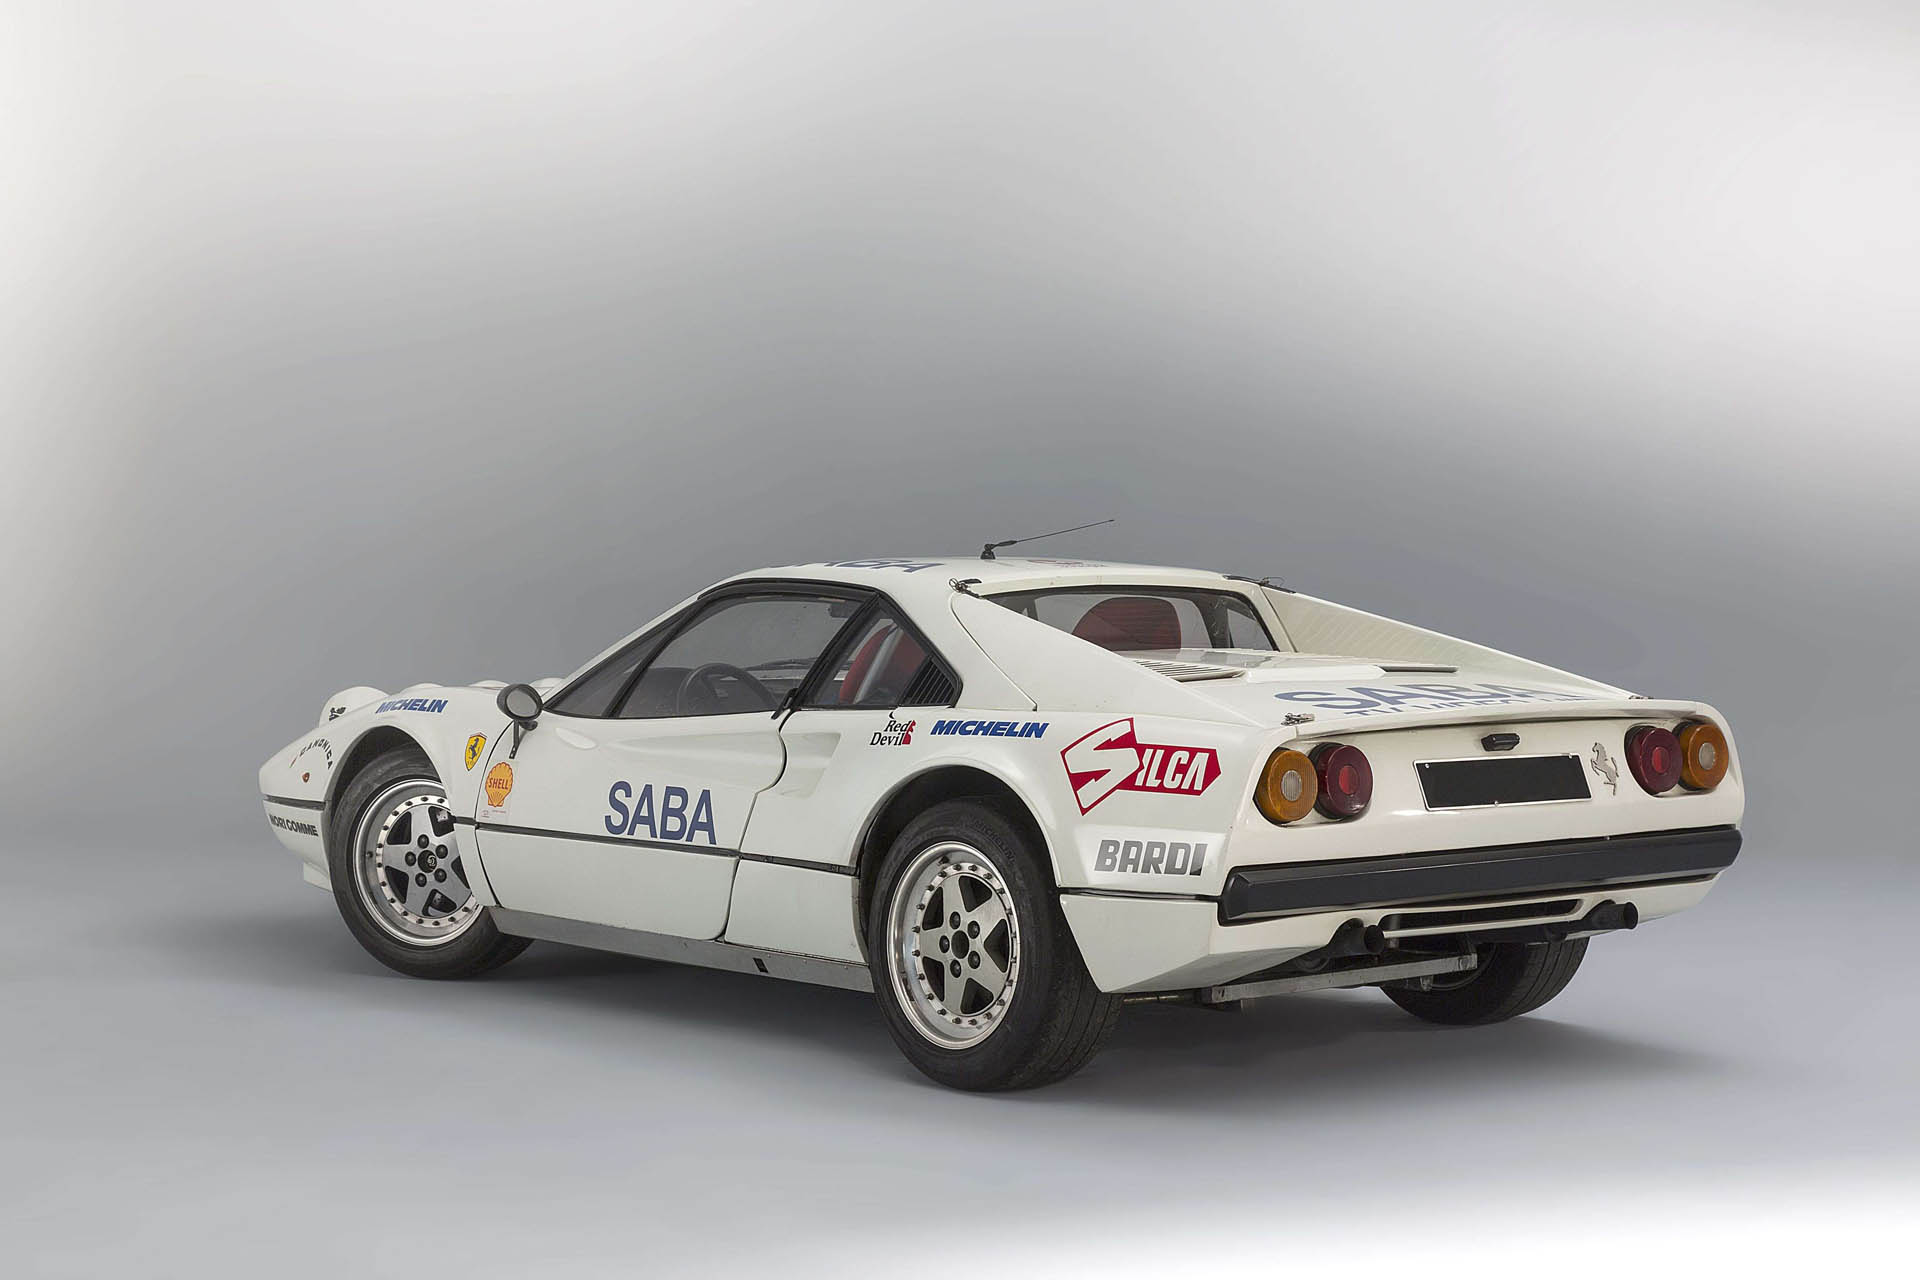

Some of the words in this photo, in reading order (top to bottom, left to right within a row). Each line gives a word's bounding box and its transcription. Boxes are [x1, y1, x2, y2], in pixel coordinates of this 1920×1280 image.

[1274, 683, 1586, 709] SABA
[375, 698, 449, 714] MICHELIN
[884, 719, 911, 732] Red
[930, 719, 1050, 739] MICHELIN
[869, 731, 905, 746] Devil
[1063, 718, 1211, 810] SILCA
[488, 777, 509, 790] SHELL
[604, 780, 717, 845] SABA
[286, 818, 319, 837] COMME
[1093, 839, 1208, 877] BARDI
